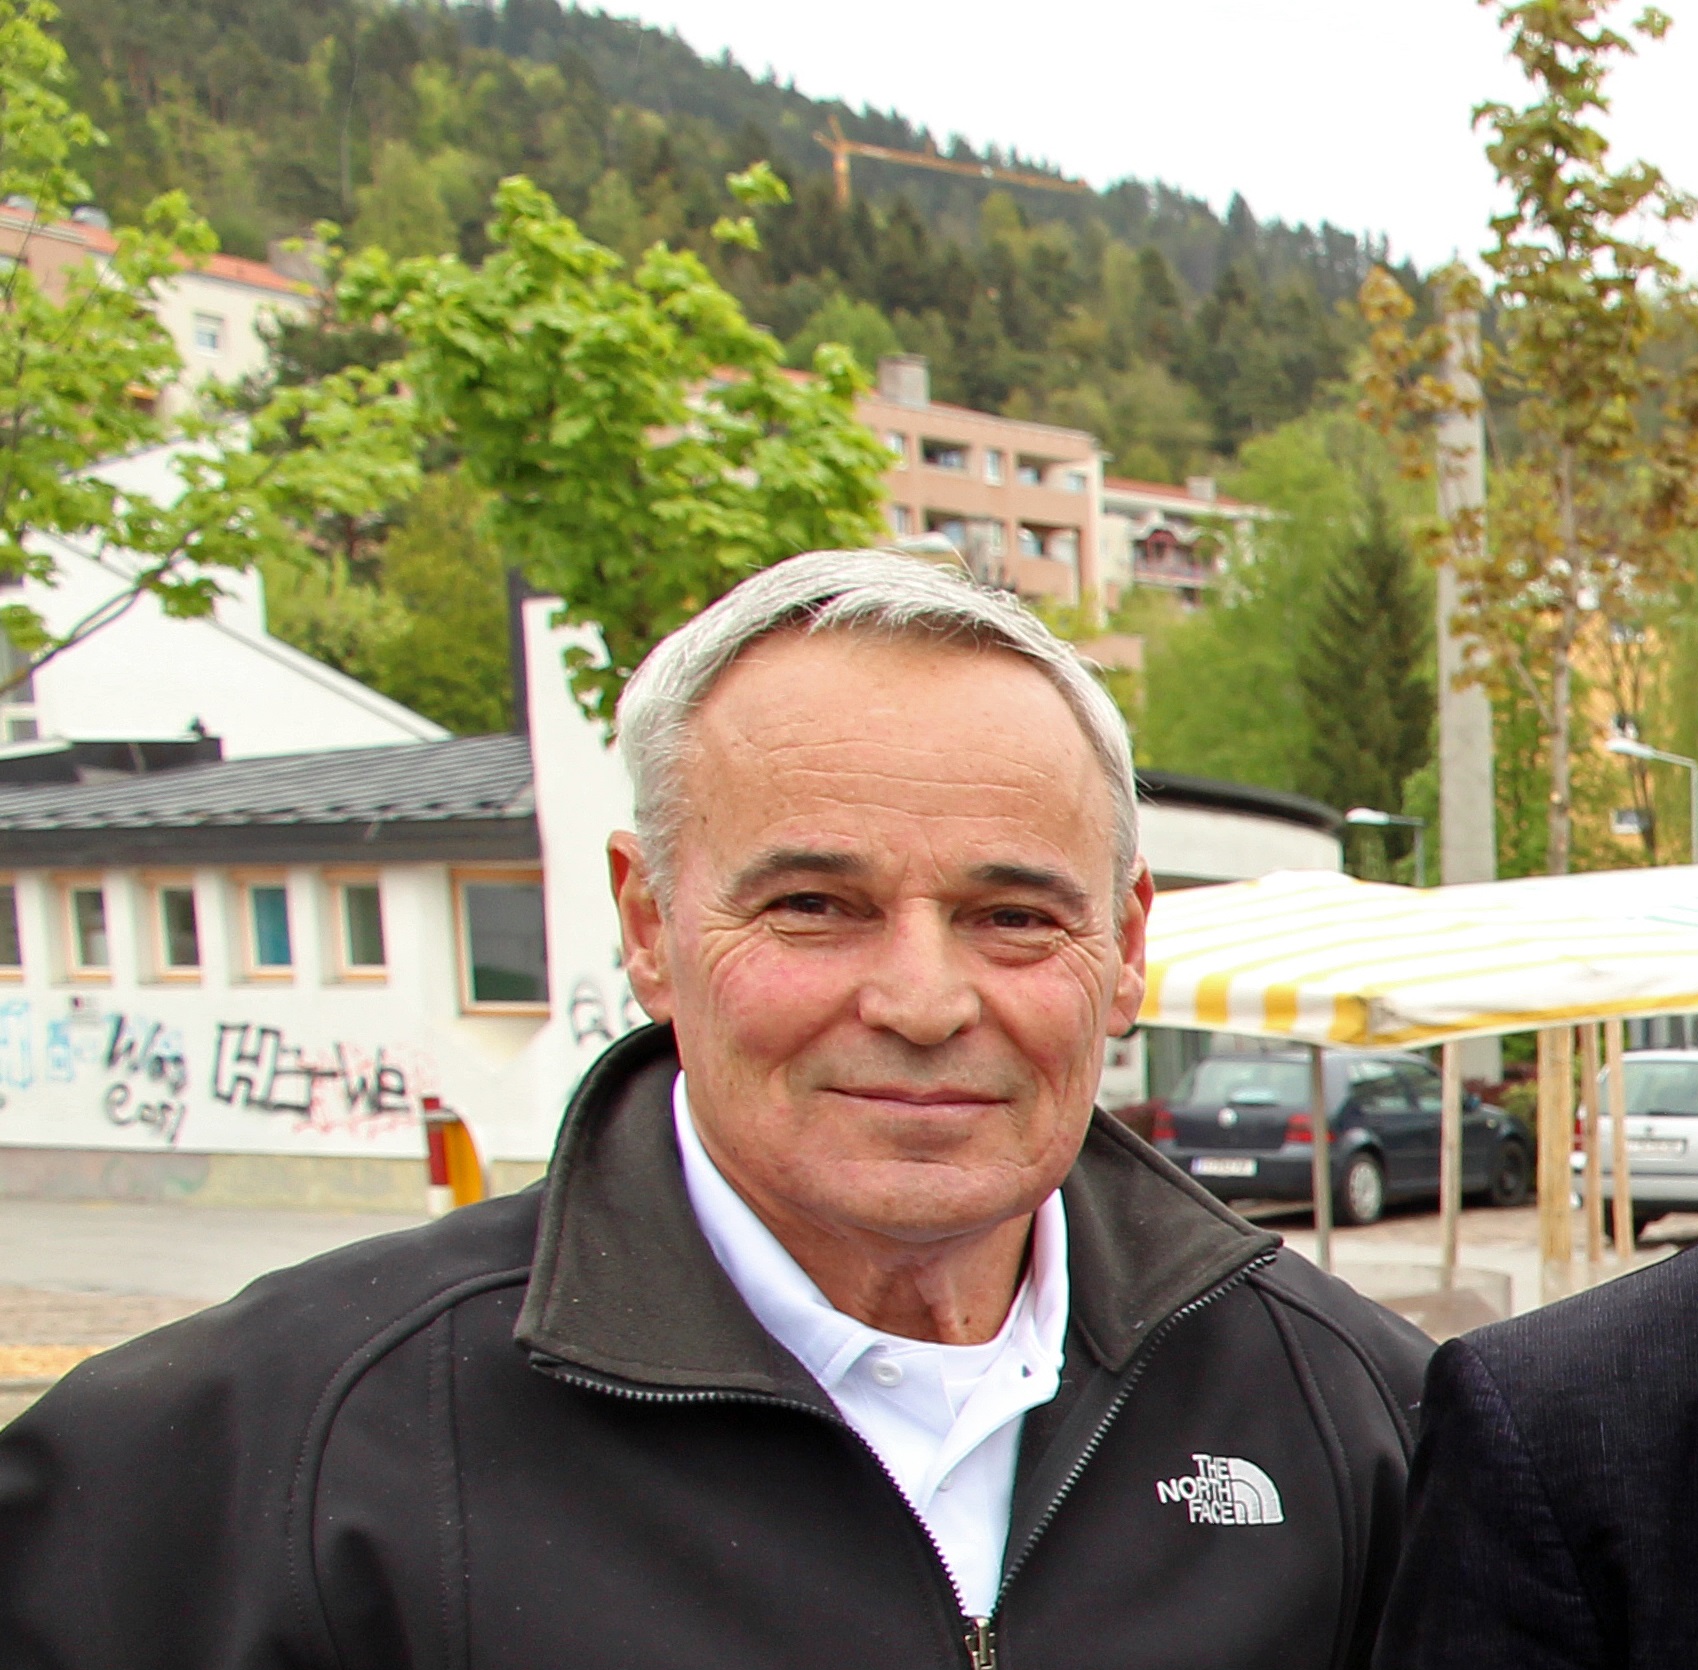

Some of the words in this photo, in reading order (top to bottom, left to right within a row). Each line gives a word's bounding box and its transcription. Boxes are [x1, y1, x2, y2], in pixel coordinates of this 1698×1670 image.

[1192, 1454, 1230, 1479] THE
[1156, 1476, 1231, 1503] NORTH
[1188, 1501, 1235, 1525] FACE
